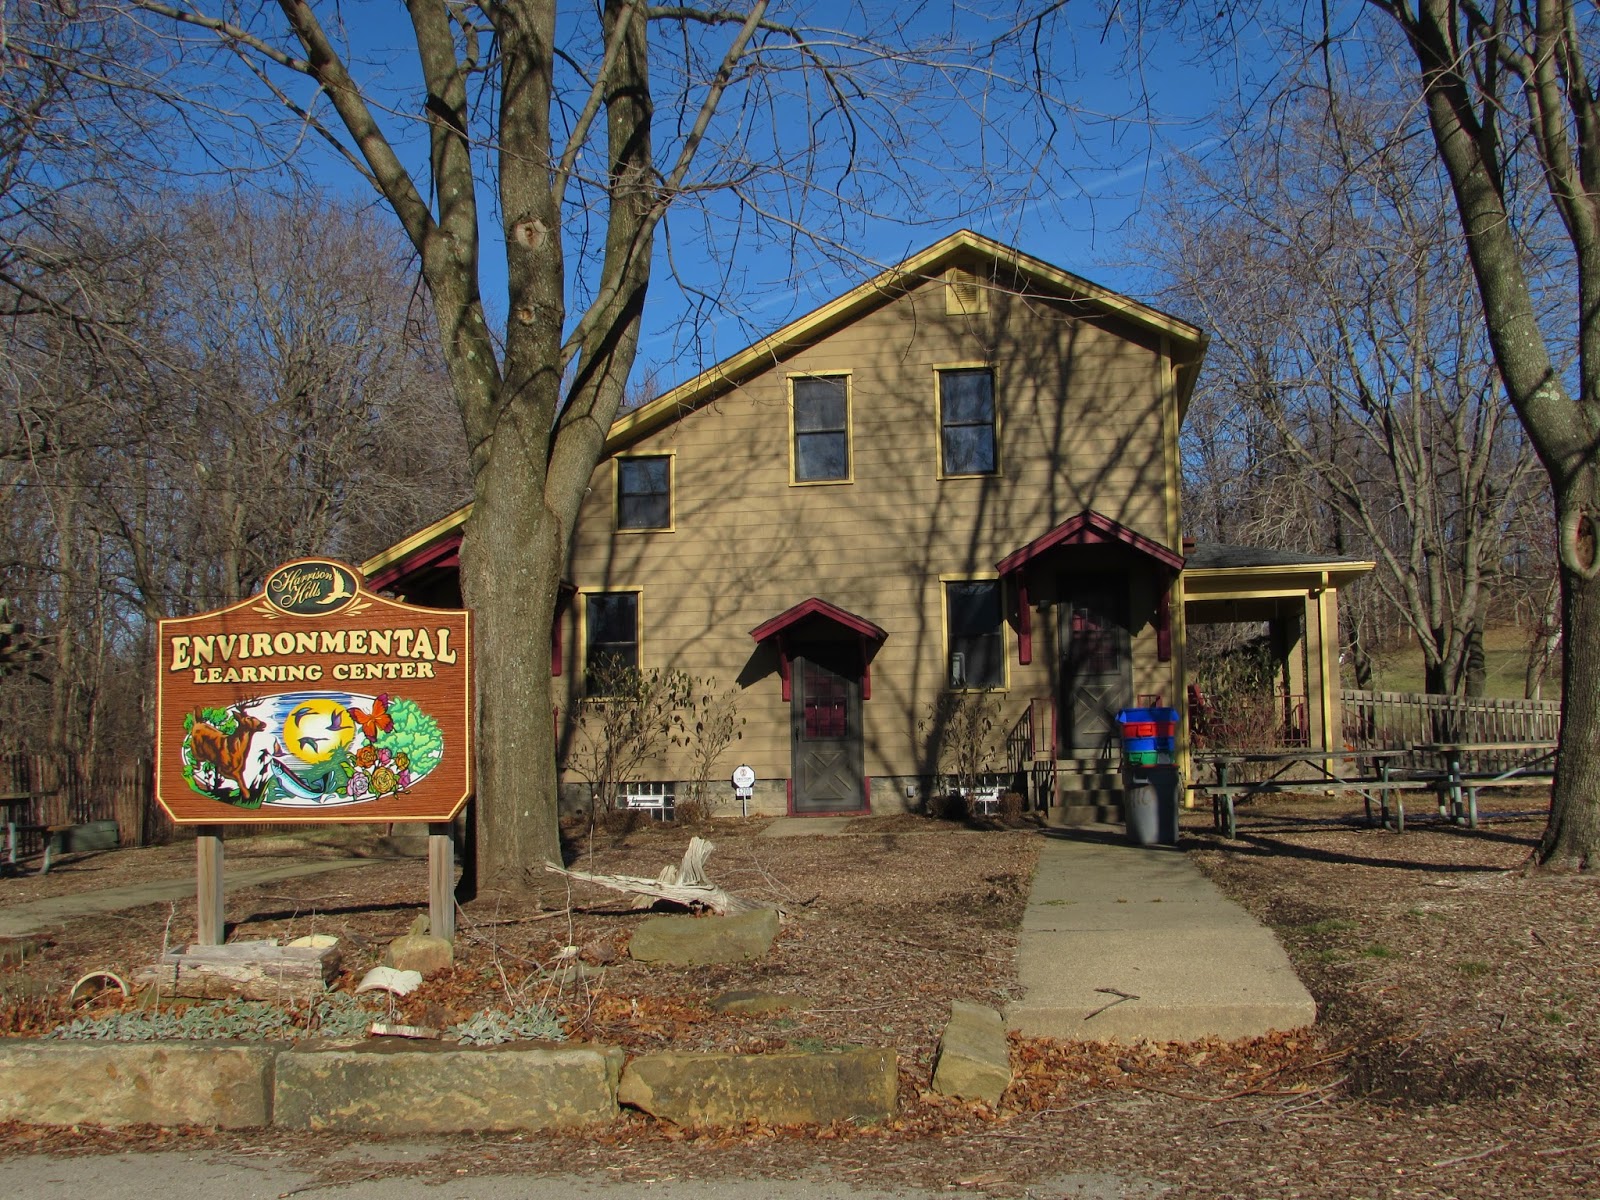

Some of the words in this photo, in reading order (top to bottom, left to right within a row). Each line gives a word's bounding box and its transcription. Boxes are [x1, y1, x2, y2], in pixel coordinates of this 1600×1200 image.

[271, 568, 333, 592] Harrison
[280, 580, 321, 608] Hills
[170, 628, 458, 671] ENVIRONMENTAL
[193, 664, 323, 684] LEARNING
[332, 662, 435, 681] CENTER
